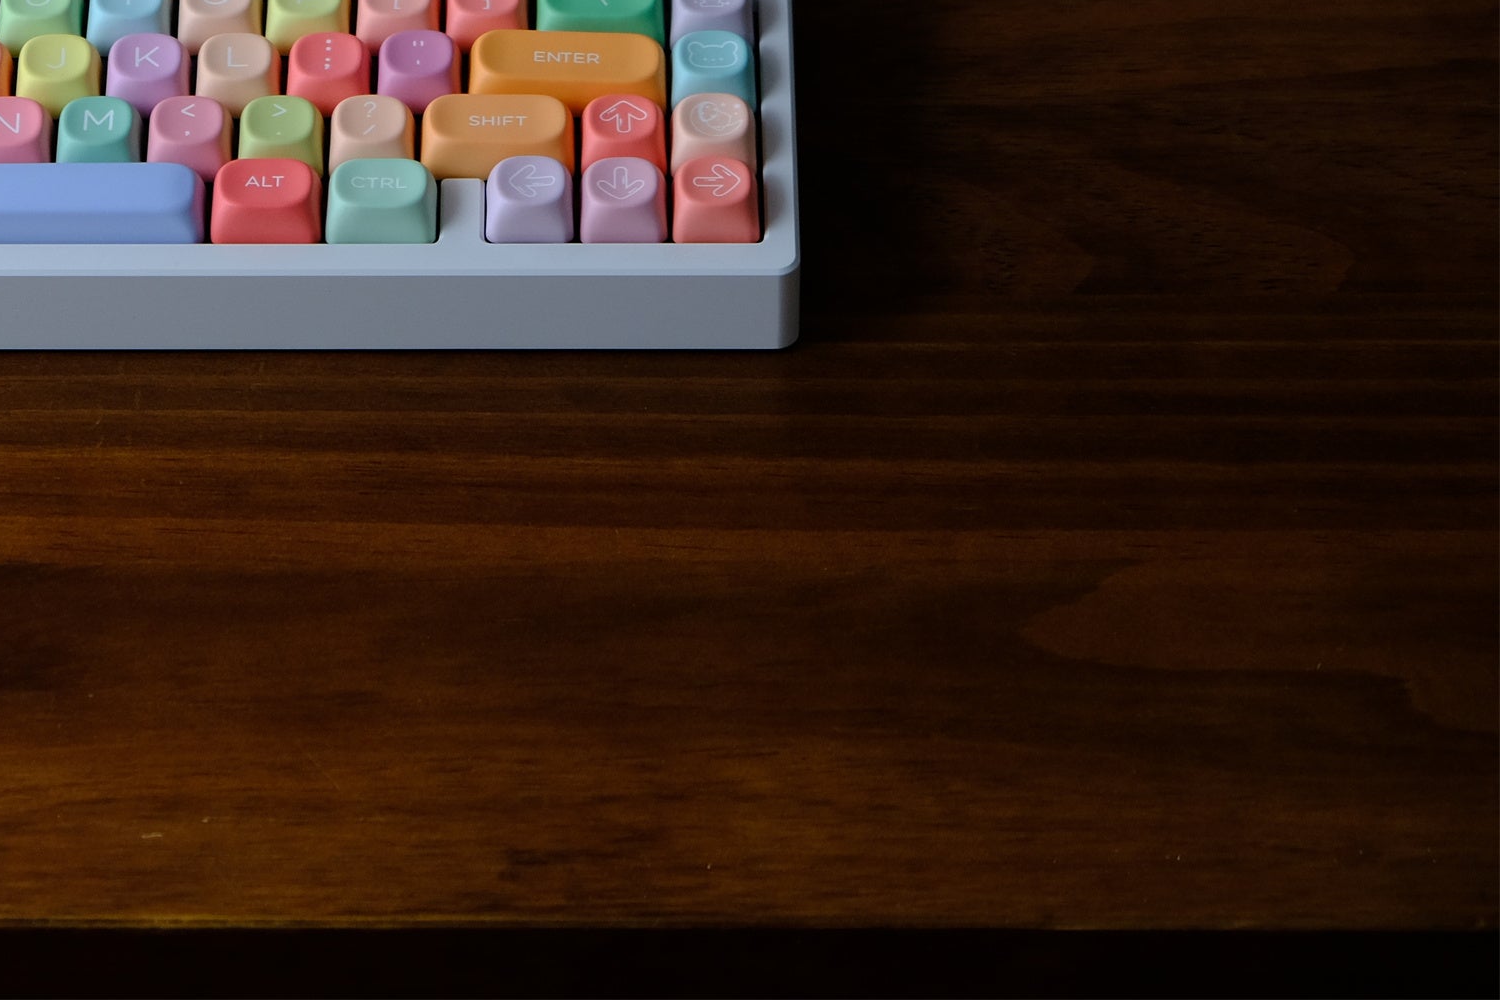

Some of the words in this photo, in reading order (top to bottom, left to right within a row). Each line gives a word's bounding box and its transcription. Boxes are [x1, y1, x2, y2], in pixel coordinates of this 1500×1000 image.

[46, 47, 66, 69] J
[135, 46, 159, 67] K
[227, 46, 248, 67] L
[533, 50, 601, 64] ENTER
[180, 103, 196, 118] <
[271, 103, 287, 118] >
[363, 101, 377, 118] ?
[83, 109, 114, 131] M
[468, 115, 528, 127] SHIFT
[362, 124, 377, 136] /
[244, 175, 285, 188] ALT
[350, 176, 408, 190] CTRL
